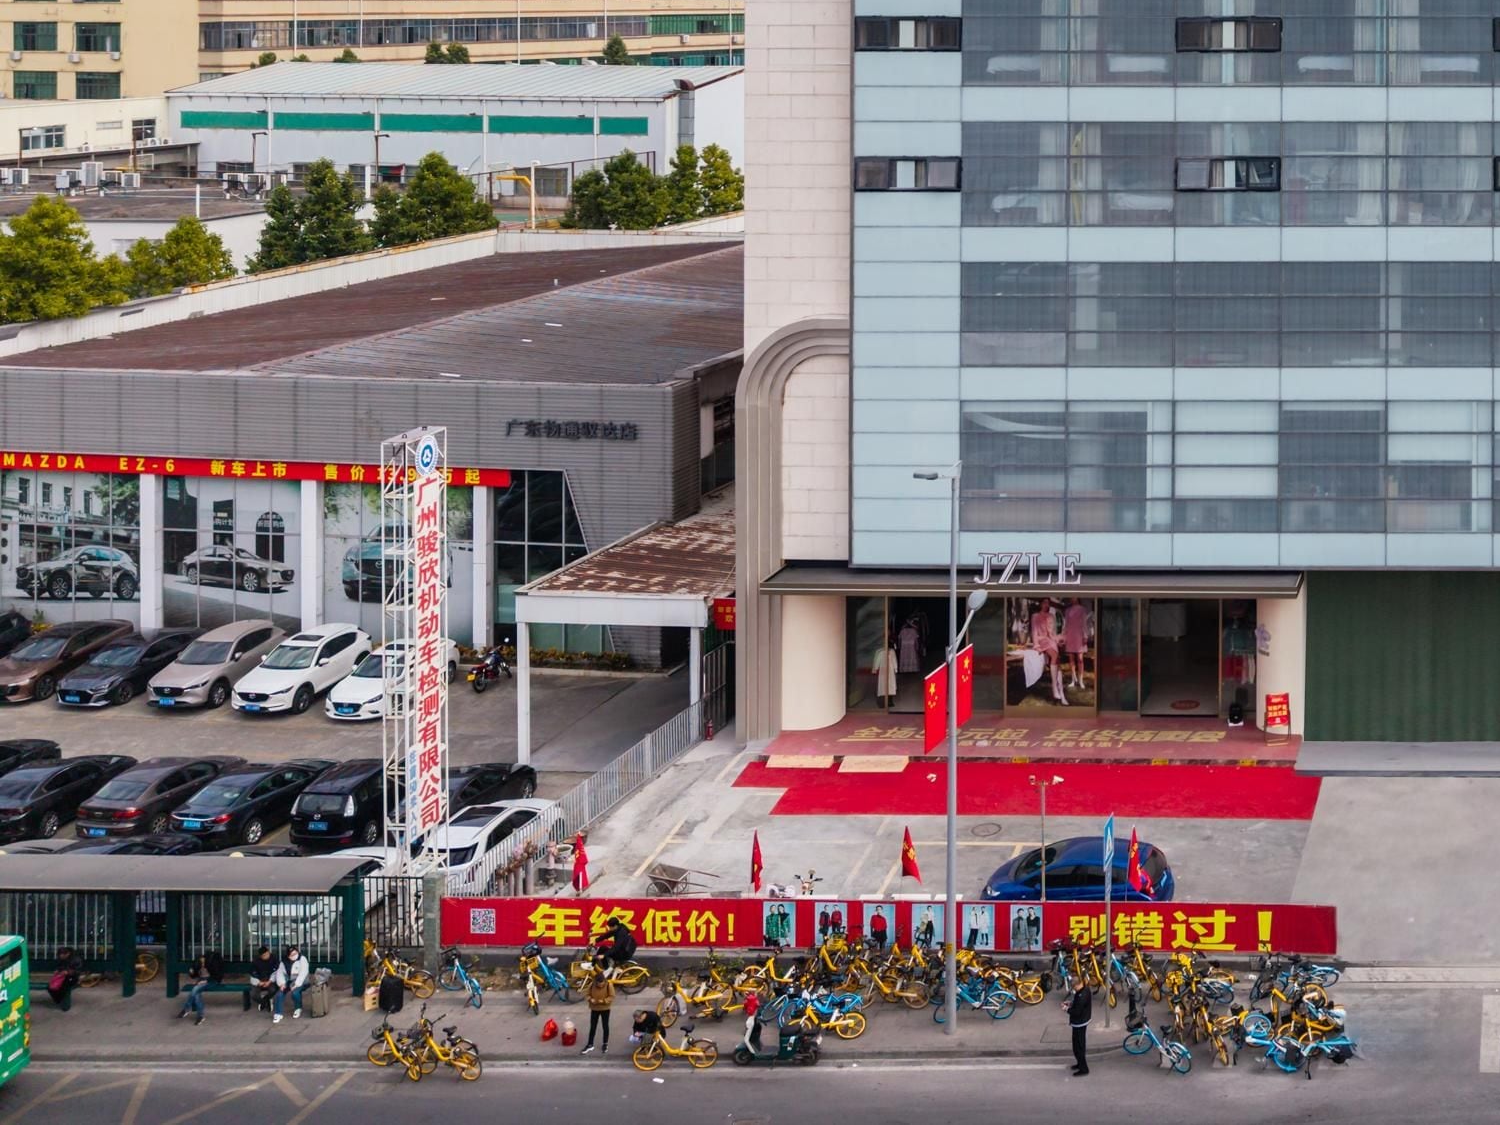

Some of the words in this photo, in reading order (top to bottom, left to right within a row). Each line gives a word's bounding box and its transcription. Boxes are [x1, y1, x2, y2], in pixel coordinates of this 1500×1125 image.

[3, 453, 85, 469] MAZDA
[119, 458, 175, 473] EZ-6
[210, 460, 287, 477] 新车上市
[974, 552, 1081, 585] JZLE
[416, 477, 441, 829] 广州骏欣机动车检测有限公司
